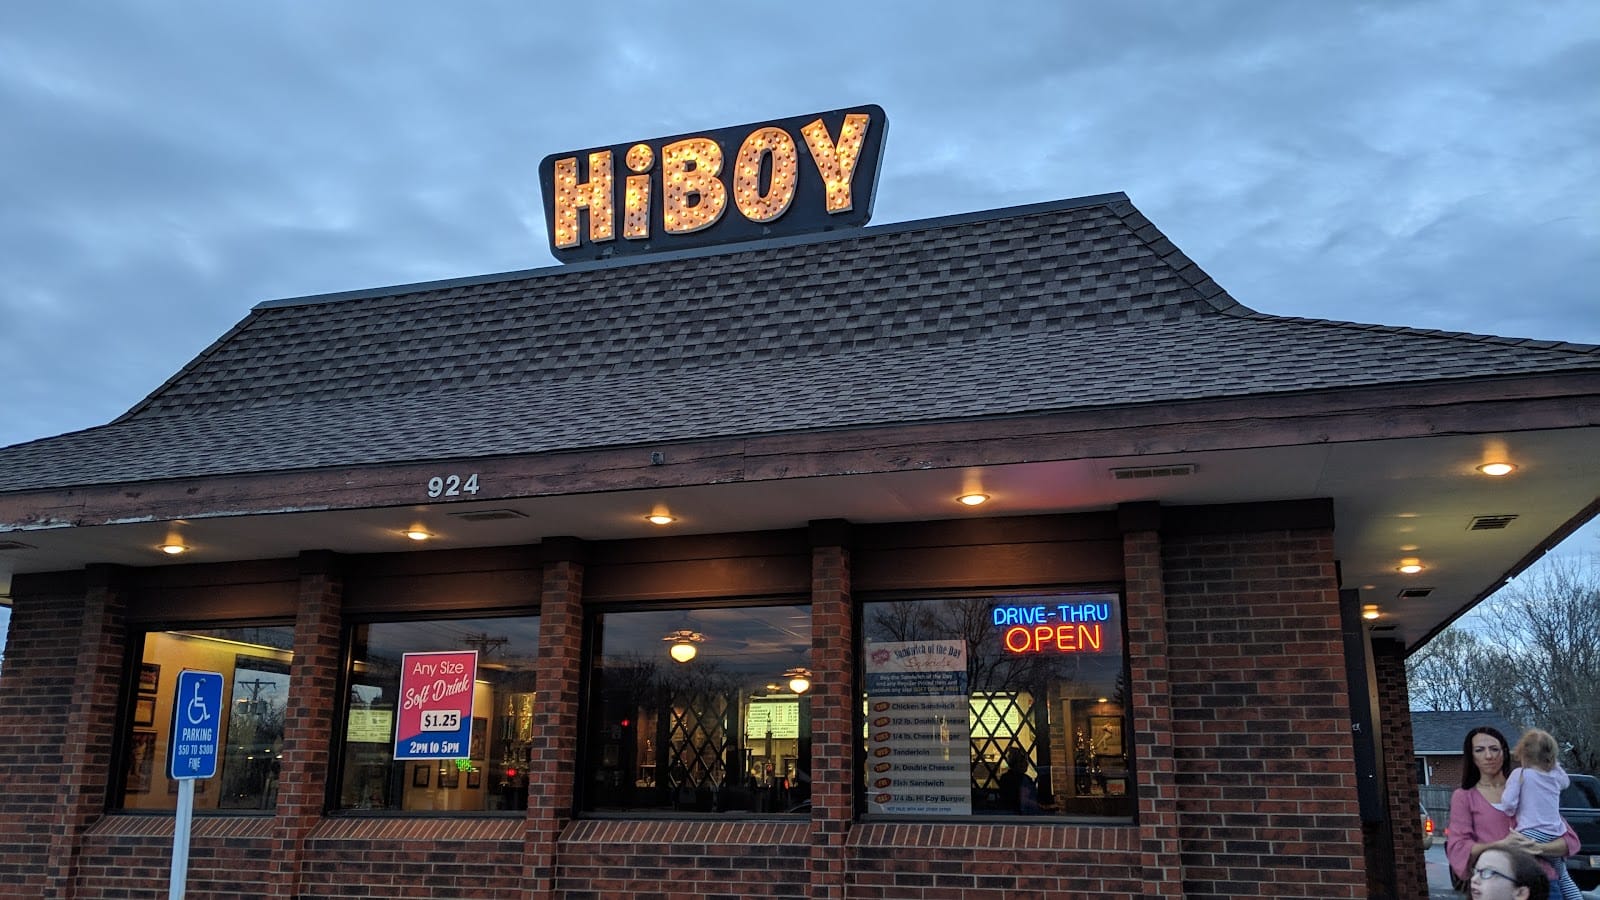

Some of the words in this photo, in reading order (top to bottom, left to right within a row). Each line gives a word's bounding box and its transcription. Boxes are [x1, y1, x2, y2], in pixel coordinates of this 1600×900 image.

[428, 473, 480, 498] 924
[993, 604, 1108, 625] DRIVE-THRU
[1006, 625, 1101, 652] OPEN
[894, 645, 926, 658] Sandwich
[928, 644, 935, 653] of
[937, 644, 948, 654] the
[949, 646, 961, 659] Day
[413, 661, 437, 677] Any
[440, 661, 464, 674] Size
[404, 685, 429, 710] Soft
[432, 674, 470, 701] Drink
[424, 713, 457, 728] $1.25
[182, 727, 212, 741] PARKING
[178, 744, 190, 756] $50
[191, 744, 198, 755] TO
[409, 741, 428, 754] 2PM
[430, 741, 439, 753] to
[441, 741, 460, 753] 5PM
[909, 779, 945, 787] Sandwich
